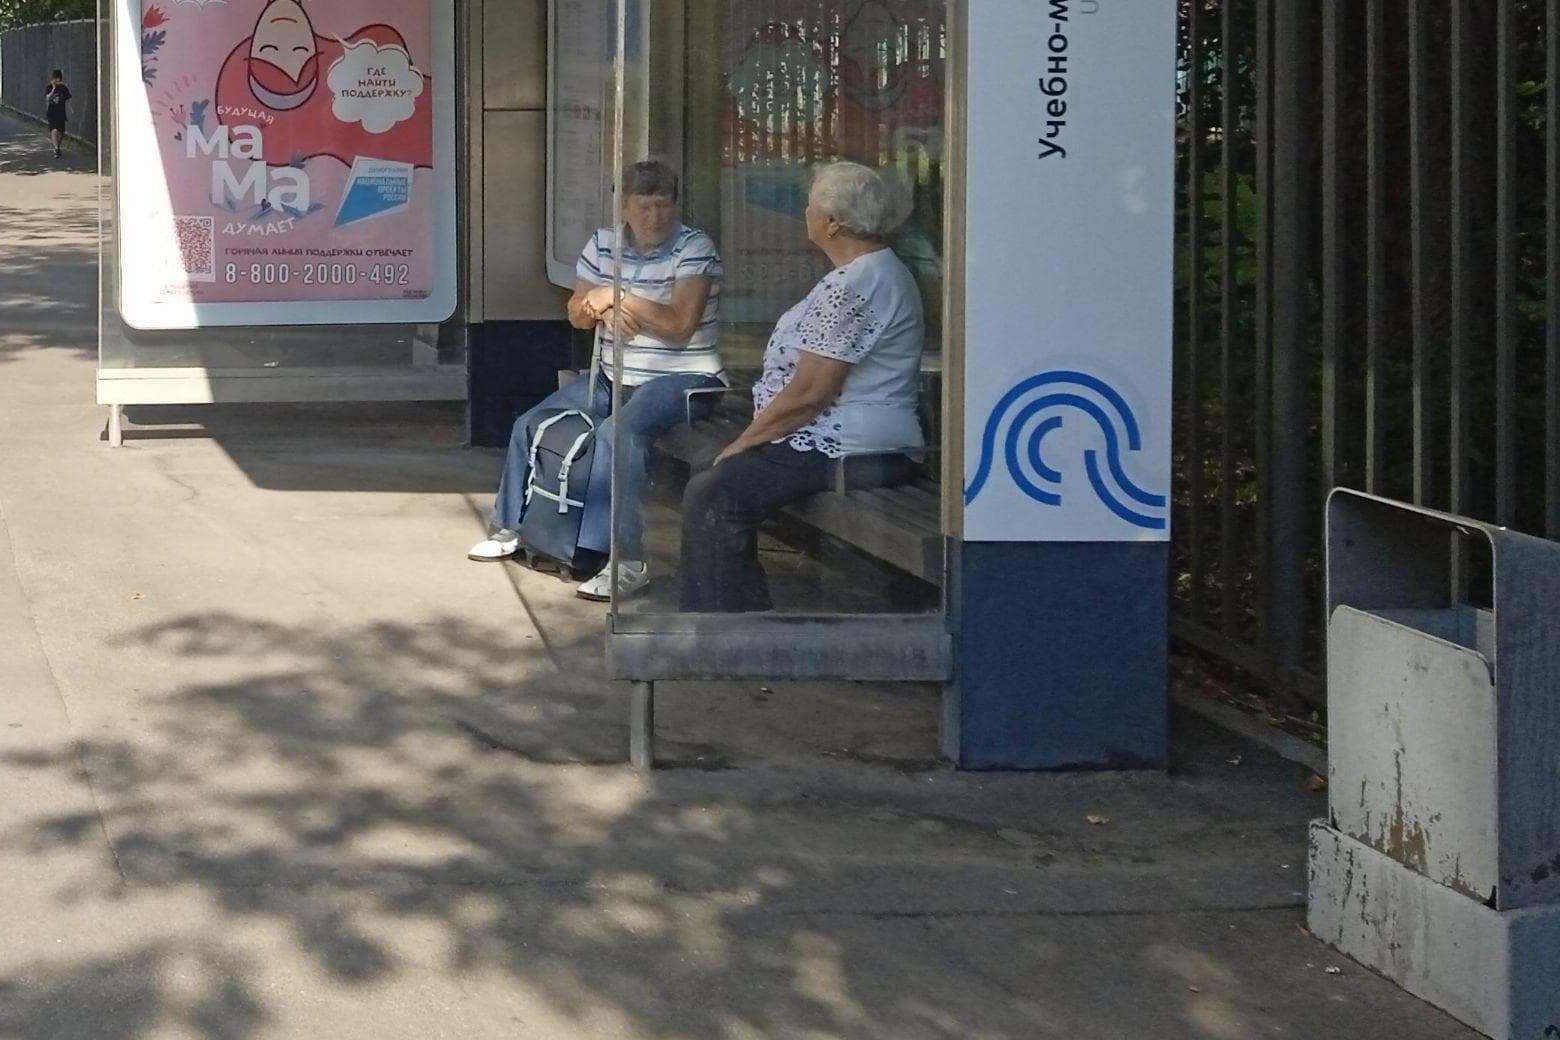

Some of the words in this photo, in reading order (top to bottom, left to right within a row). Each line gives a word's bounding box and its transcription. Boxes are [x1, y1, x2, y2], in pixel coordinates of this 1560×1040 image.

[367, 67, 387, 76] ГДЕ
[341, 89, 413, 98] ПОДДЕРЖКУ?
[217, 105, 274, 125] БУДУЩАЯ
[222, 217, 295, 236] ДУМАЕТ
[225, 248, 269, 256] ГОРЯЧАЯ
[271, 248, 303, 256] ЛИНИЯ
[305, 248, 363, 257] ПОДДЕРЖКИ
[365, 248, 414, 257] ОТВЕЧАЕТ
[225, 263, 410, 285] 8-800-2000-492
